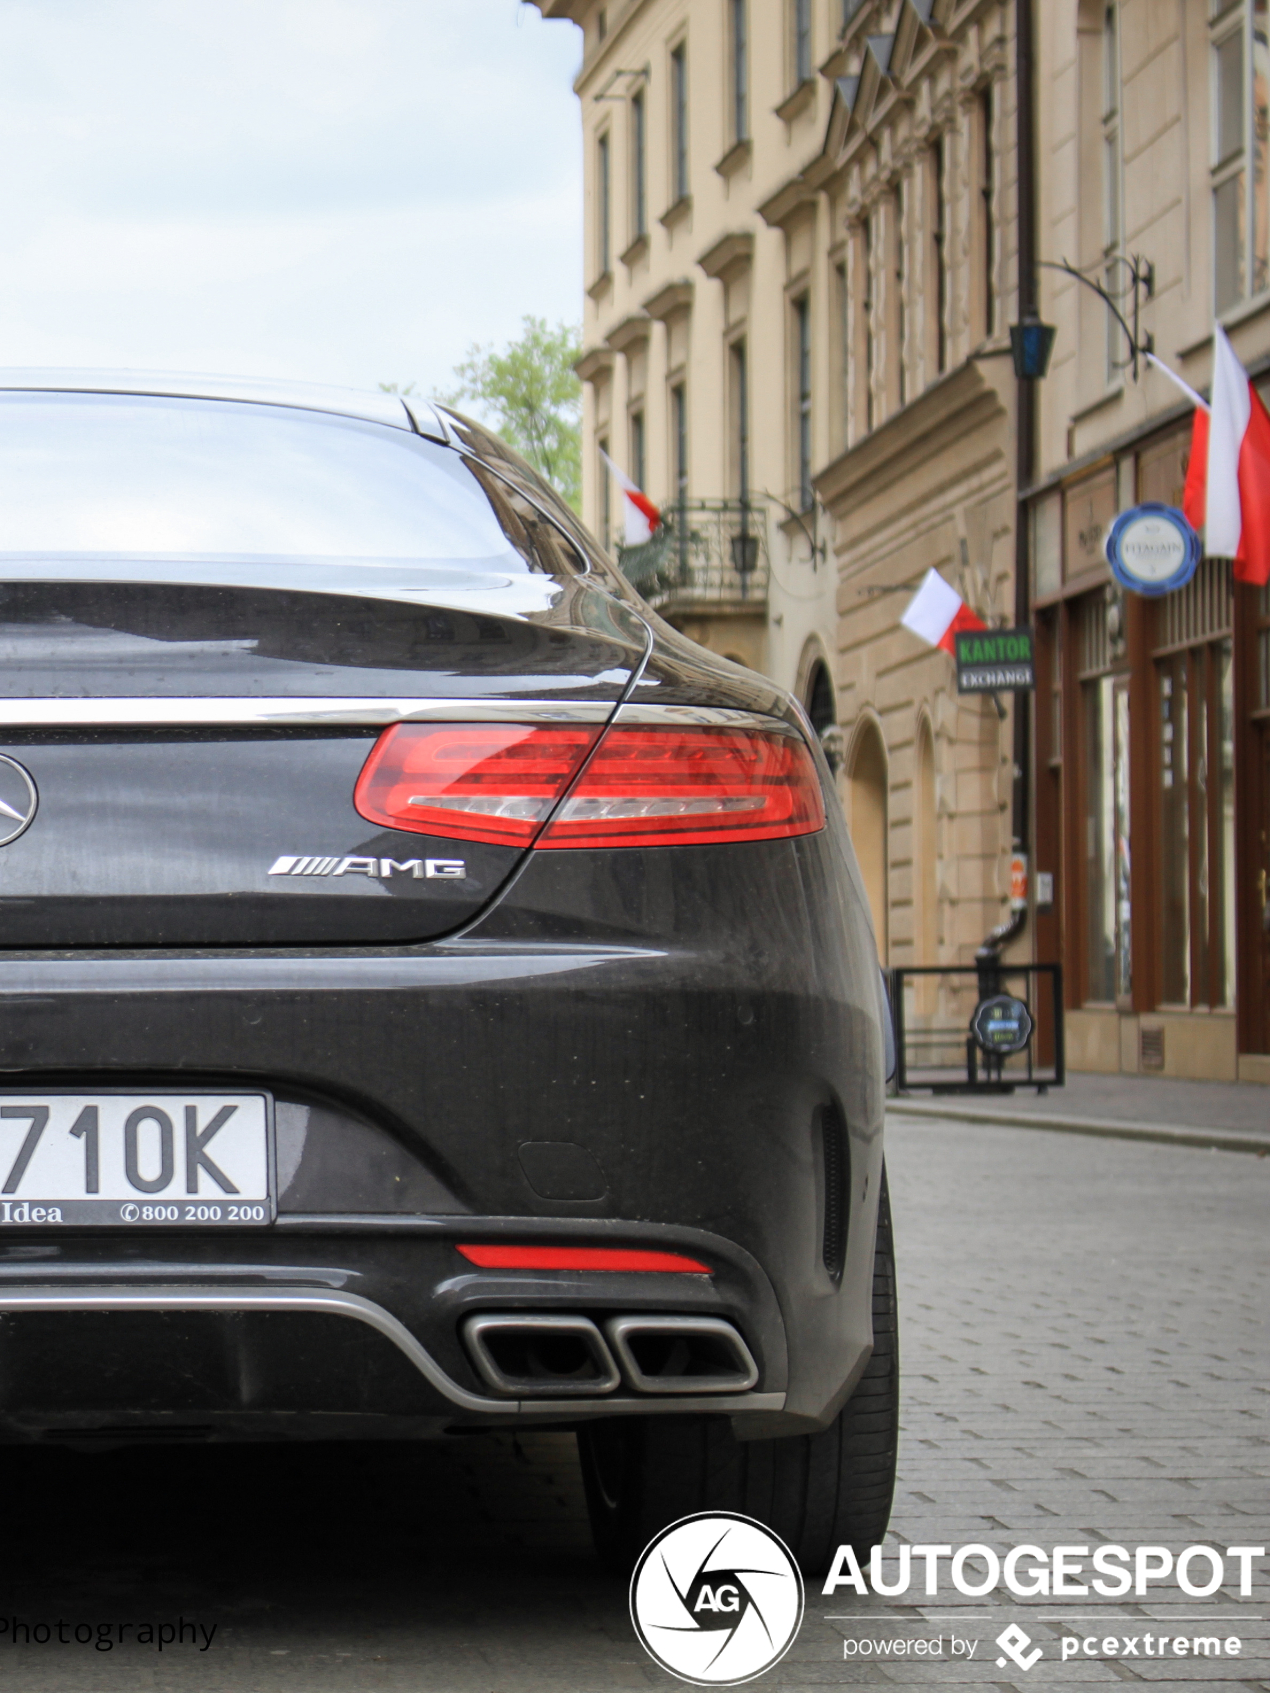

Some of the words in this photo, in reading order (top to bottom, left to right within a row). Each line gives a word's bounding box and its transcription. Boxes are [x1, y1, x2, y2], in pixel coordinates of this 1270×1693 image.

[960, 635, 1031, 662] KANTOR
[962, 668, 1032, 688] EXCHANGE
[332, 856, 467, 879] AMG
[2, 1202, 64, 1224] Idea
[141, 1204, 179, 1222] 800
[185, 1204, 222, 1222] 200
[227, 1204, 265, 1222] 200
